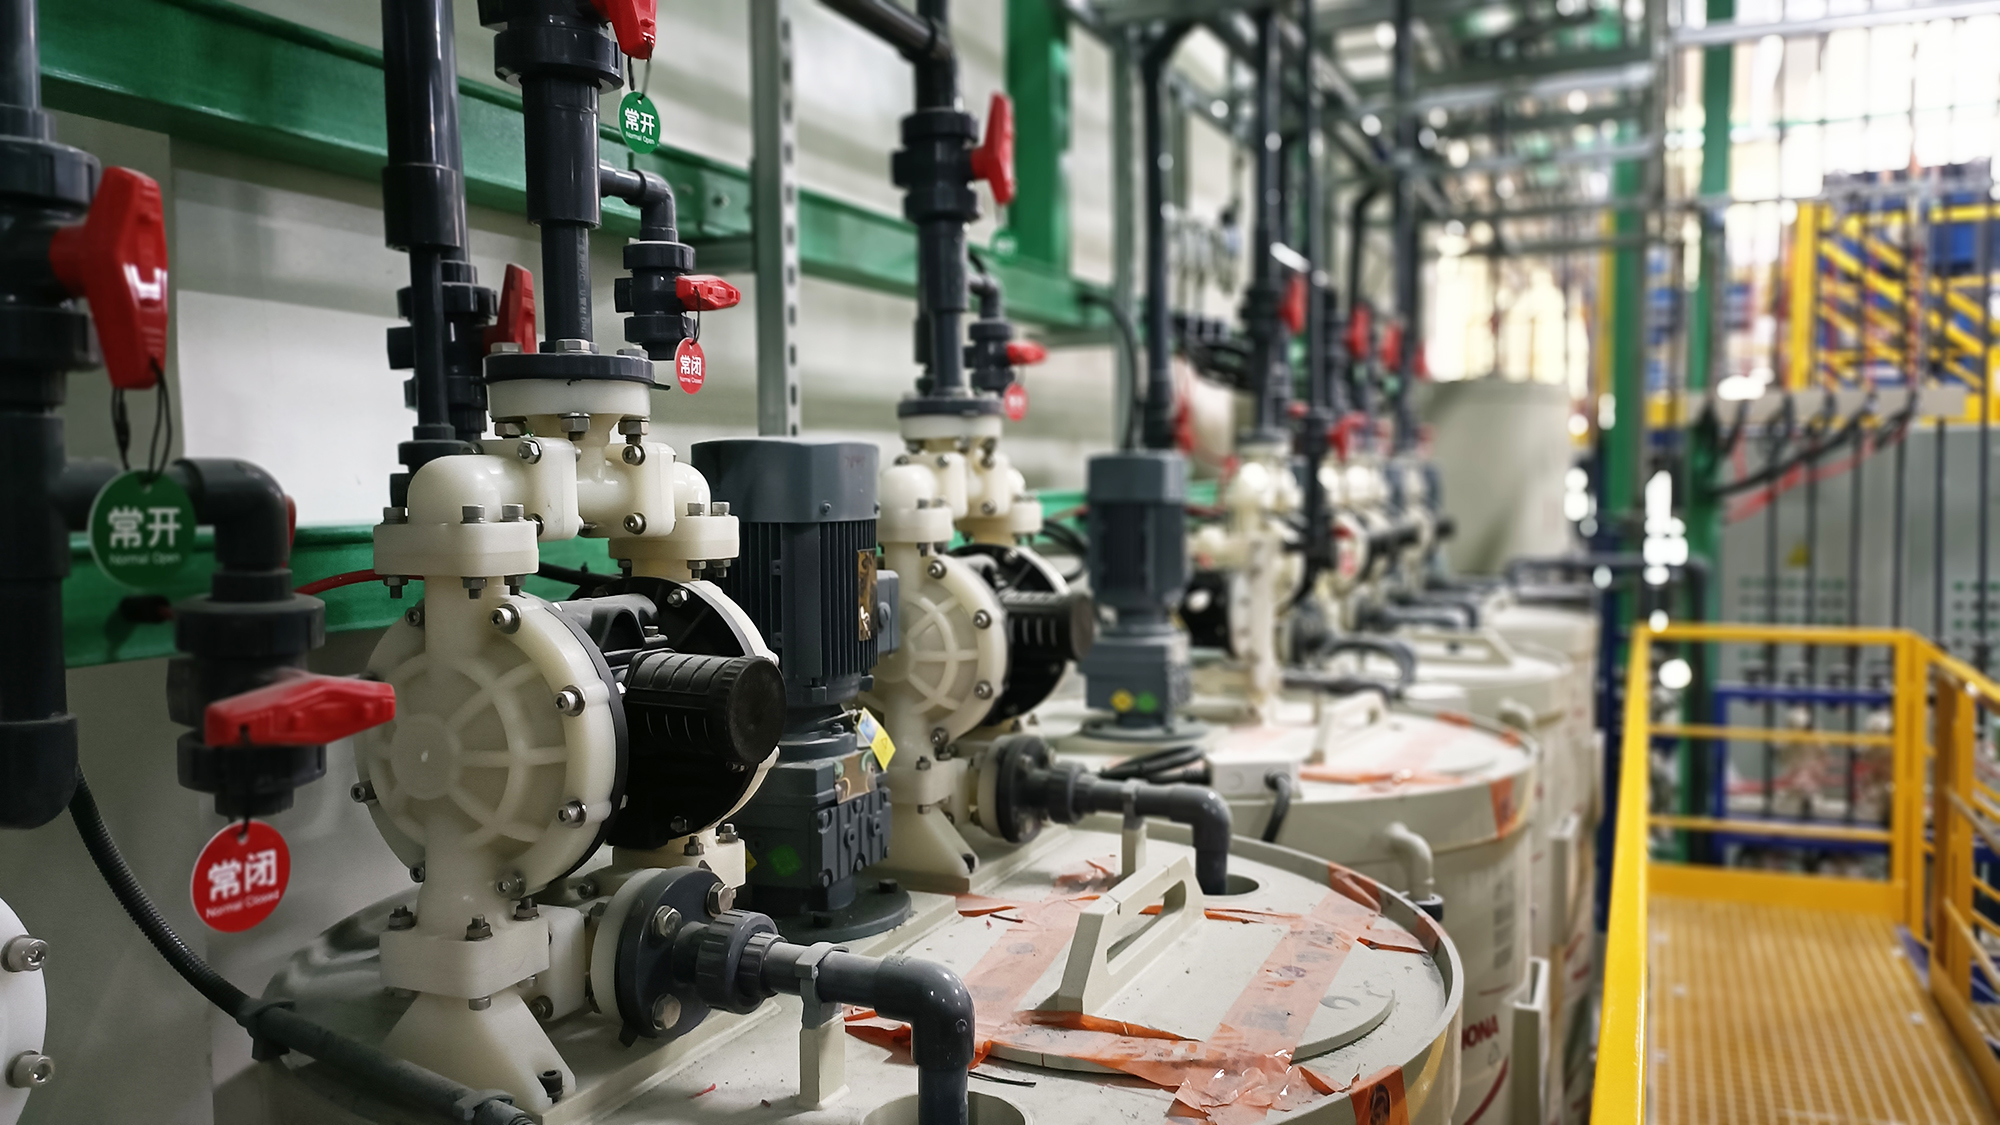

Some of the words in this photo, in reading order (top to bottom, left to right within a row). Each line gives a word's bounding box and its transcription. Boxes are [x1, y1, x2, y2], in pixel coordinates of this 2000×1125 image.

[624, 107, 655, 136] 常开
[642, 135, 655, 145] Open
[679, 355, 702, 377] 常闭
[107, 505, 182, 549] 常开
[108, 553, 149, 566] Normal
[151, 551, 181, 567] Open
[207, 848, 277, 903] 常闭
[205, 900, 243, 919] Normal
[244, 889, 280, 909] Closed
